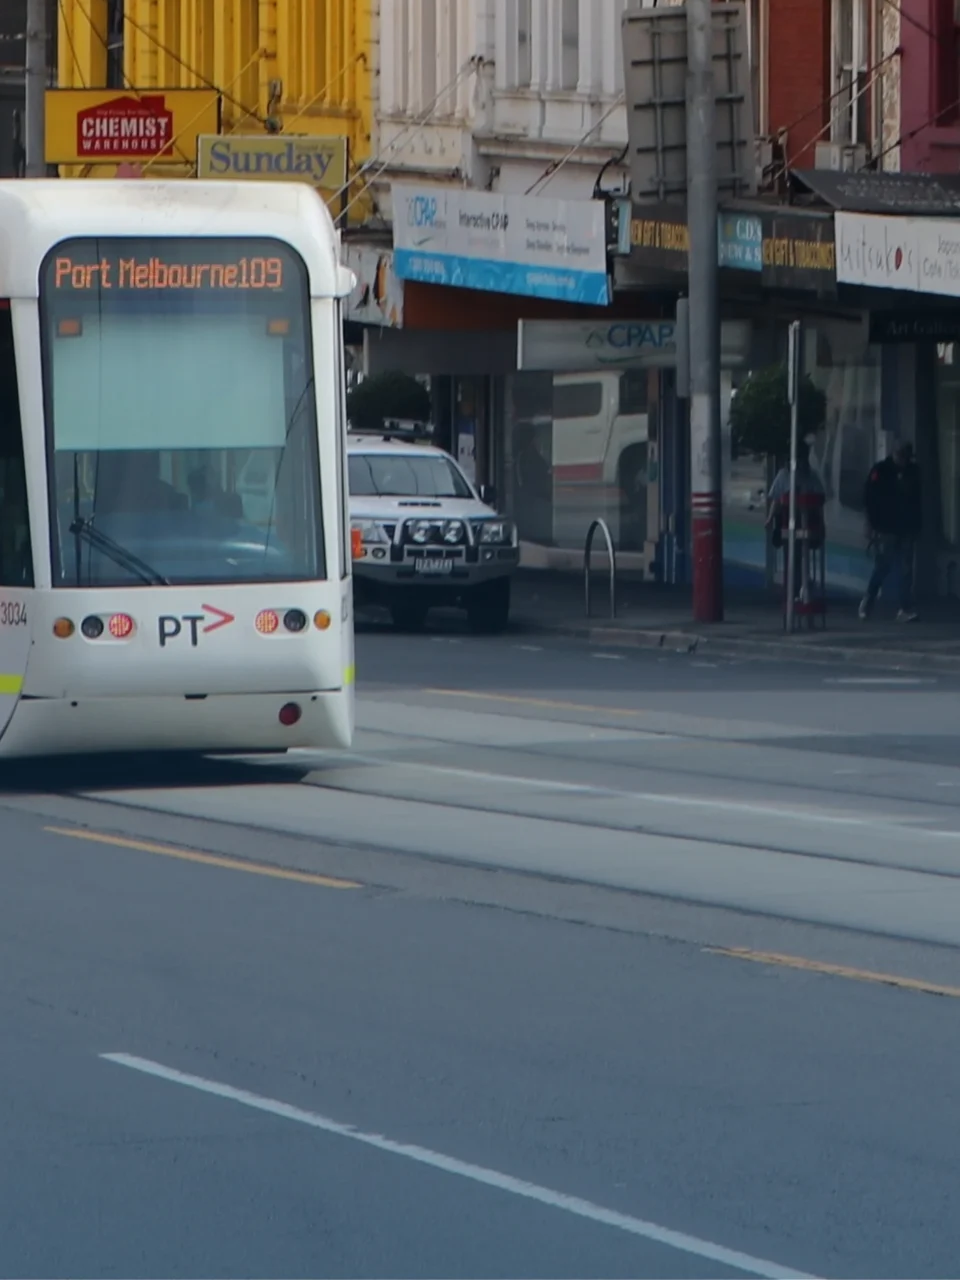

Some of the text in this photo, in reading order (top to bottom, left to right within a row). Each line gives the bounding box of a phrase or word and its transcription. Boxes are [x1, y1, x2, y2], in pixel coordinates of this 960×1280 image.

[81, 116, 169, 138] CHEMIST
[82, 138, 166, 151] WAREHOUSE
[208, 141, 335, 180] Sunday
[54, 256, 112, 289] Port
[0, 600, 28, 627] 3034
